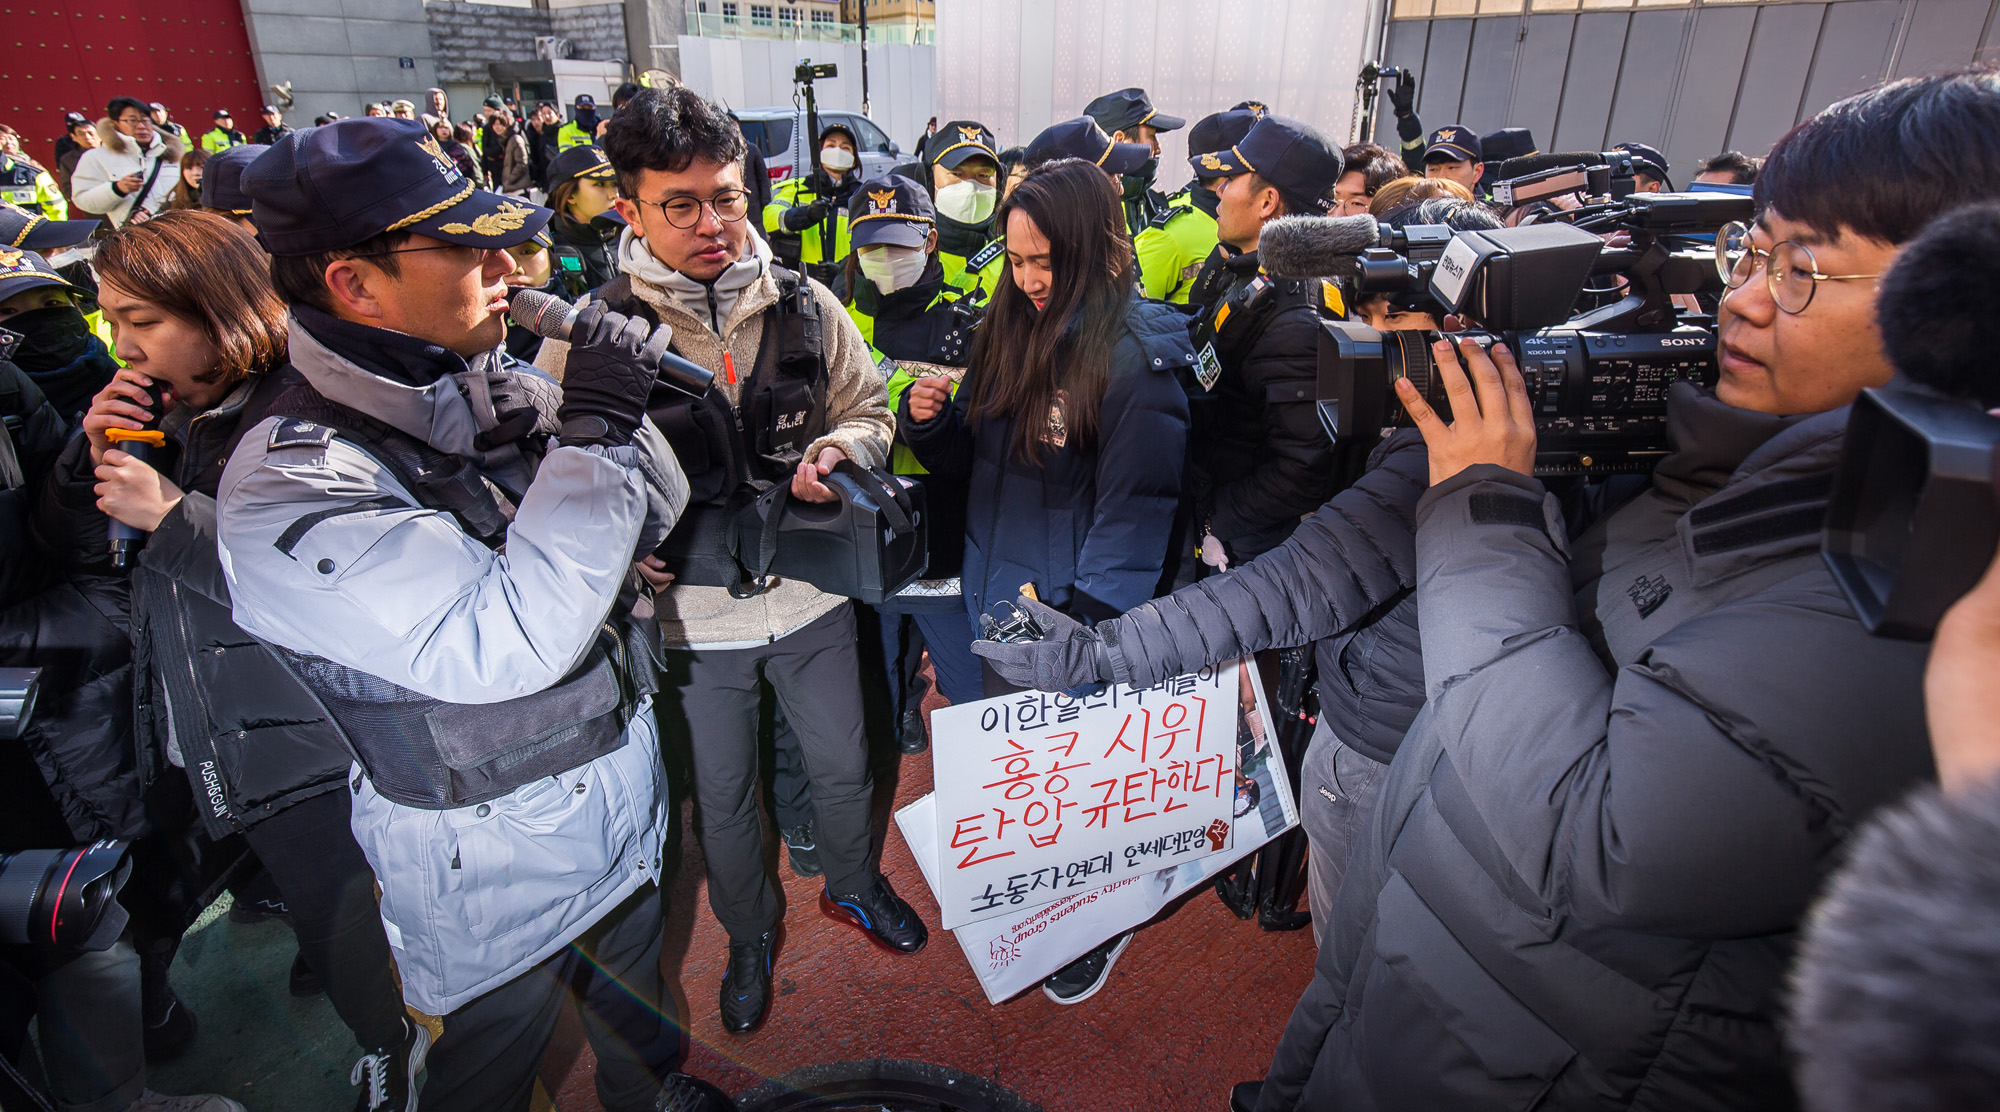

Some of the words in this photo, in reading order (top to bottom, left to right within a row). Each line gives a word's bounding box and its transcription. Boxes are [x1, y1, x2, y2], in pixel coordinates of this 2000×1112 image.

[1525, 337, 1548, 345] 4K
[1660, 338, 1706, 346] SONY
[776, 419, 804, 431] POLICE
[982, 732, 1091, 800] 홍콩
[1103, 696, 1206, 763] 시위
[199, 761, 228, 818] PUSH&GUN
[1318, 785, 1336, 804] Jeep
[950, 796, 1078, 870] 탄압
[1082, 754, 1233, 829] 규탄한다
[970, 851, 1113, 912] 노동자연대
[1050, 891, 1099, 924] Students
[1013, 920, 1047, 944] Group
